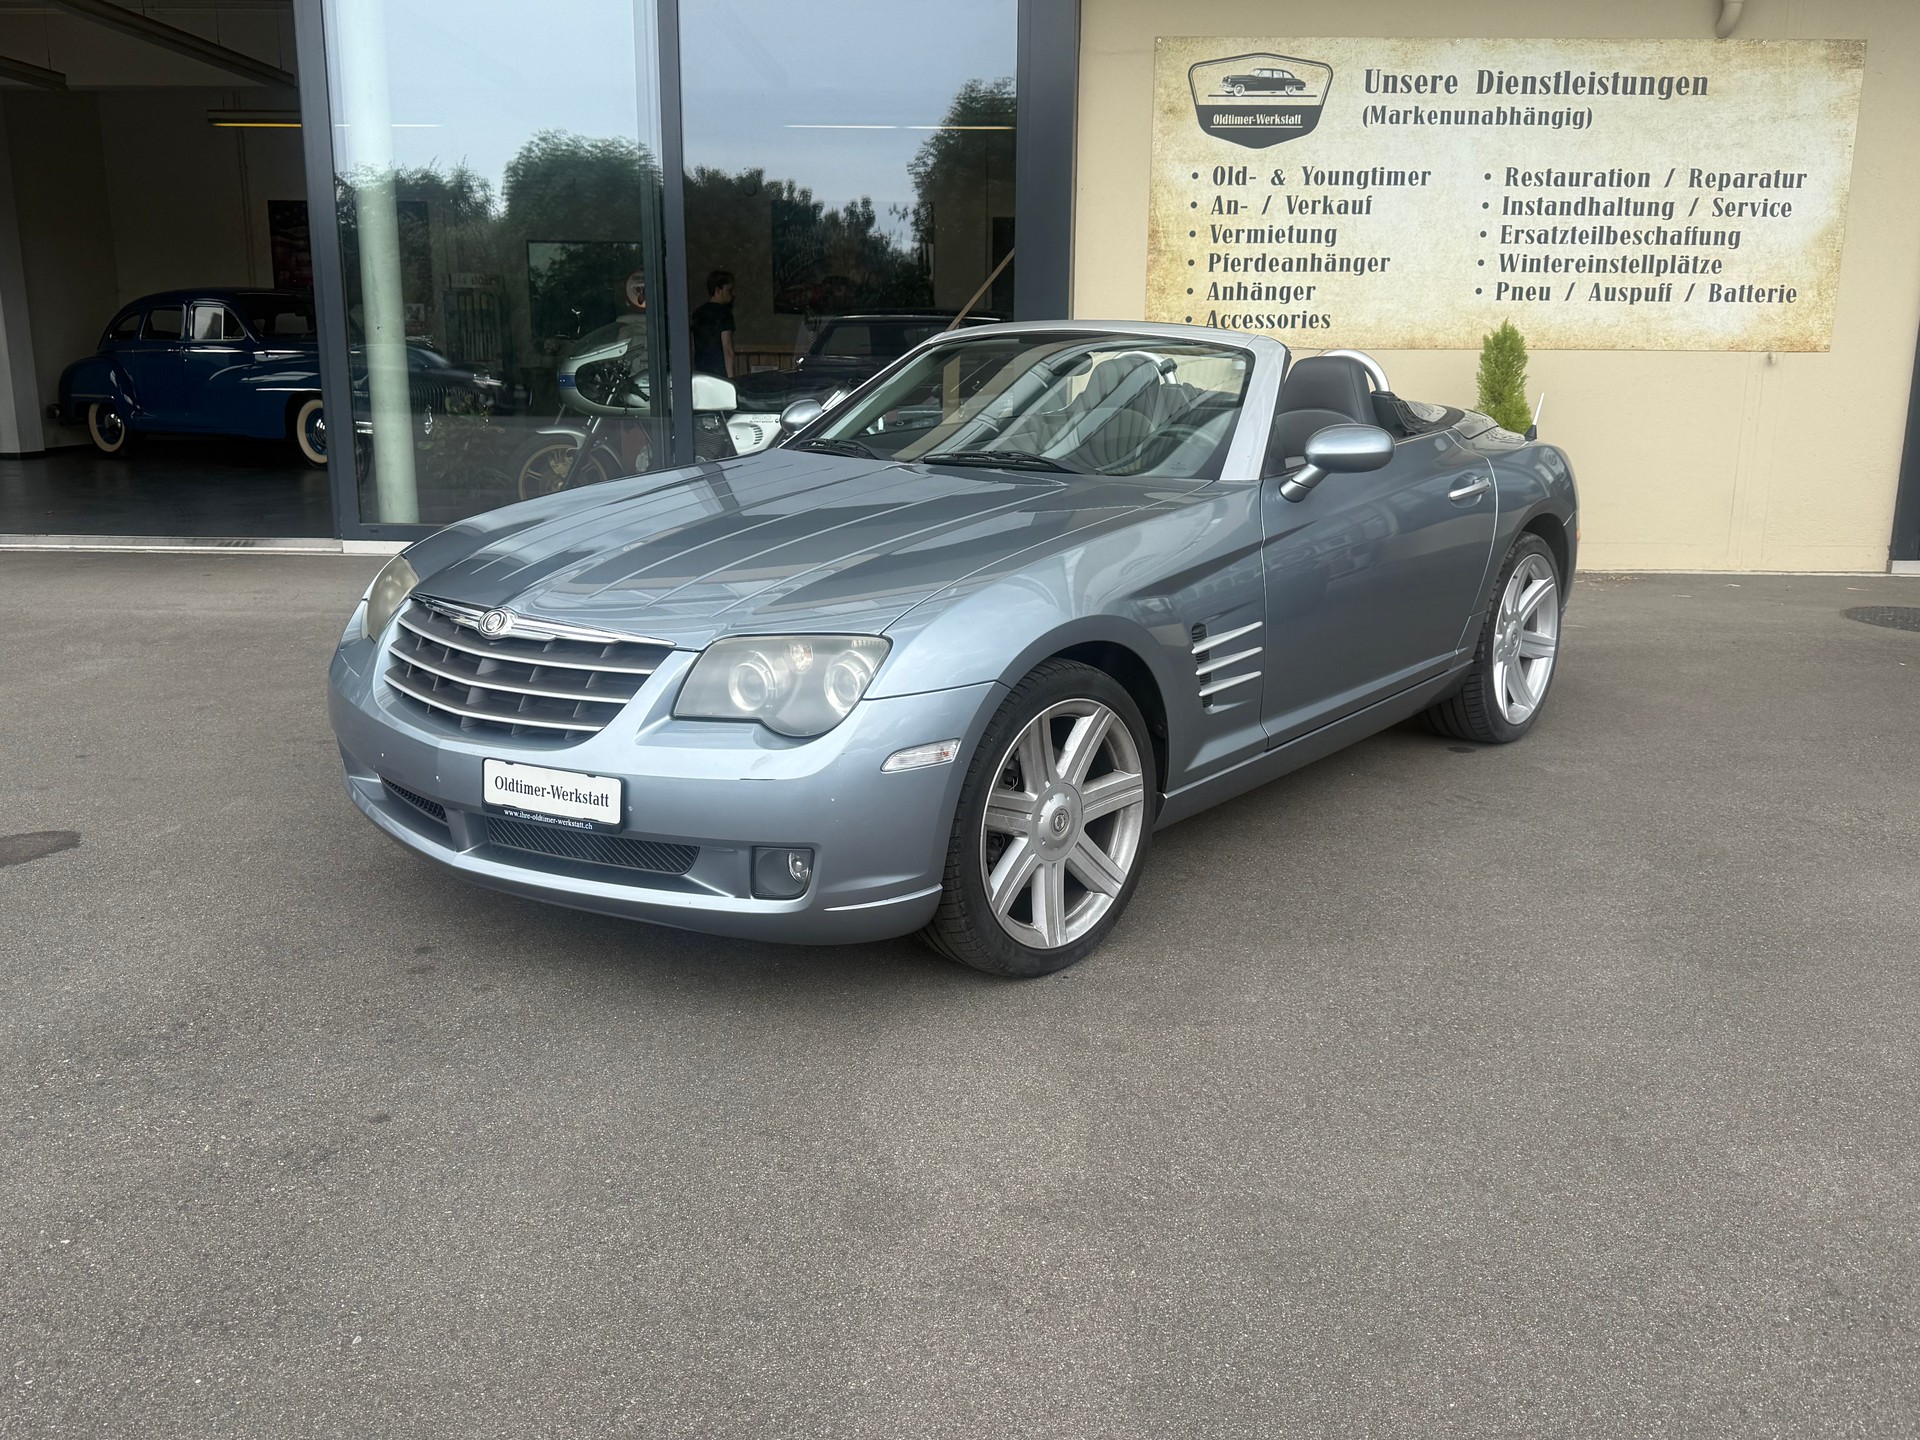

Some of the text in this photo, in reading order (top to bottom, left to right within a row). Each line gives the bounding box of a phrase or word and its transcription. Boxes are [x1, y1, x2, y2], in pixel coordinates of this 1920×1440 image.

[1365, 68, 1708, 101] Unsere Dienstleistungen
[1212, 112, 1303, 126] Oldtimer-Werkstatt
[1362, 105, 1593, 130] (Markenunabhängig)
[1212, 165, 1432, 190] Old- & Youngtimer
[1504, 166, 1808, 192] Restauration / Reparatur
[1210, 194, 1373, 215] An- / Verkauf
[1502, 196, 1792, 221] Instandhaltung / Service
[1210, 224, 1337, 248] Vermietung
[1500, 224, 1741, 250] Ersatzteilbeschaffung
[1208, 252, 1391, 276] Pferdeanhänger
[1499, 253, 1723, 278] Wintereinstellplätze
[1206, 281, 1317, 305] Anhänger
[1495, 281, 1797, 306] Pneu / Auspuff / Batterie
[1205, 309, 1331, 329] Accessories
[494, 775, 610, 808] Oldtimer-Werkstatt
[503, 808, 593, 830] www.ihre-oldtimer-werkstatt.ch
